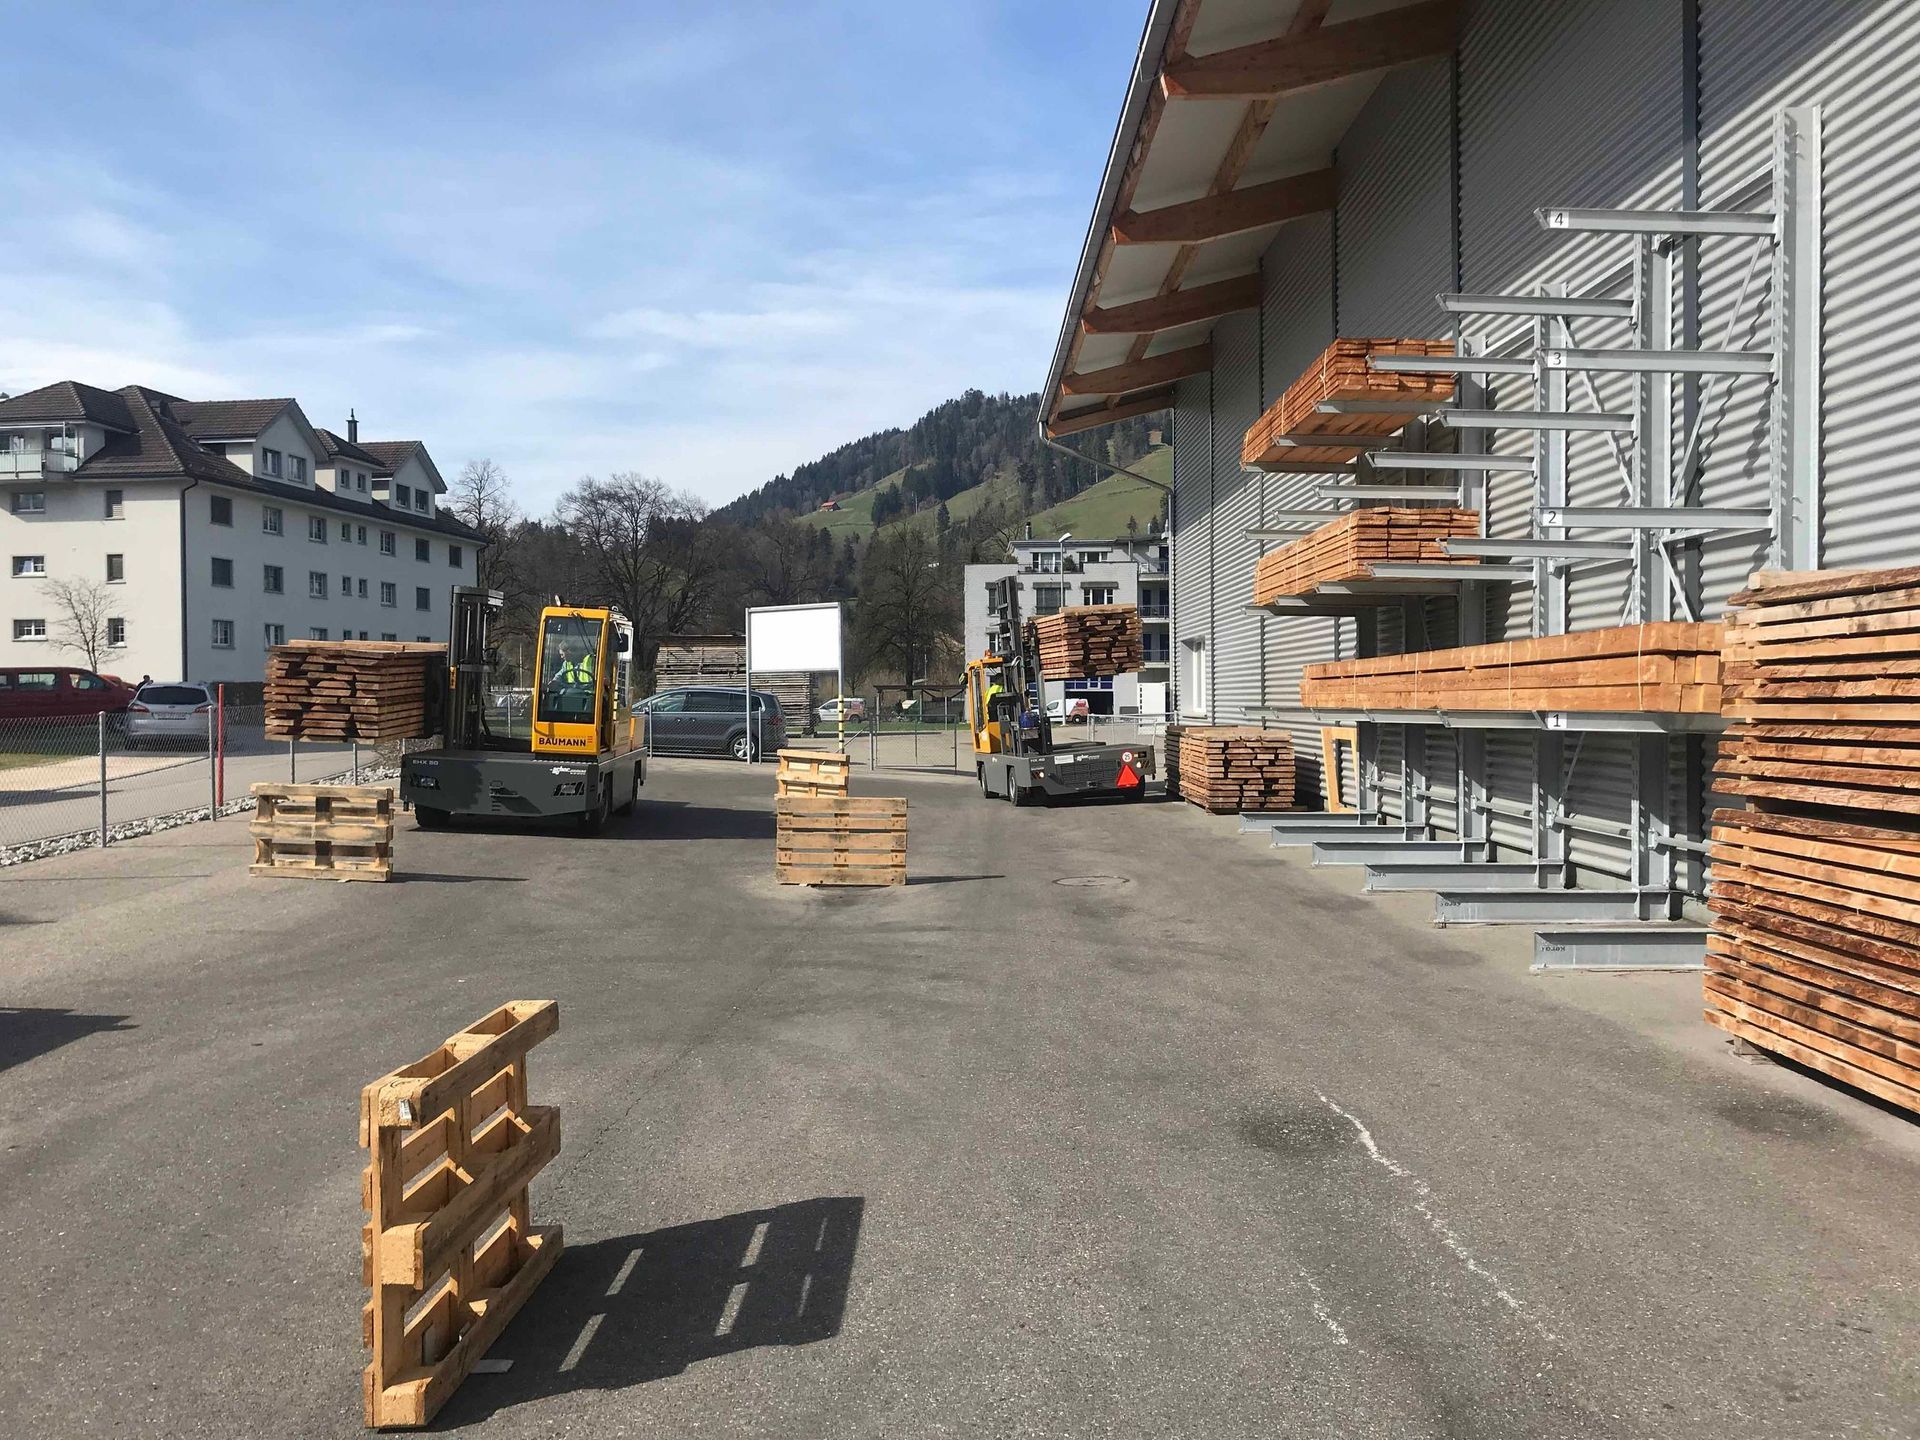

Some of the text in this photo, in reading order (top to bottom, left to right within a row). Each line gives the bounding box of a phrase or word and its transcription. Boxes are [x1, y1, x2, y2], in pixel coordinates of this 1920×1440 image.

[1554, 212, 1563, 226] 4
[1553, 351, 1562, 365] 3
[1548, 510, 1557, 524] 2
[1553, 713, 1561, 727] 1
[538, 737, 587, 747] BAUMANN
